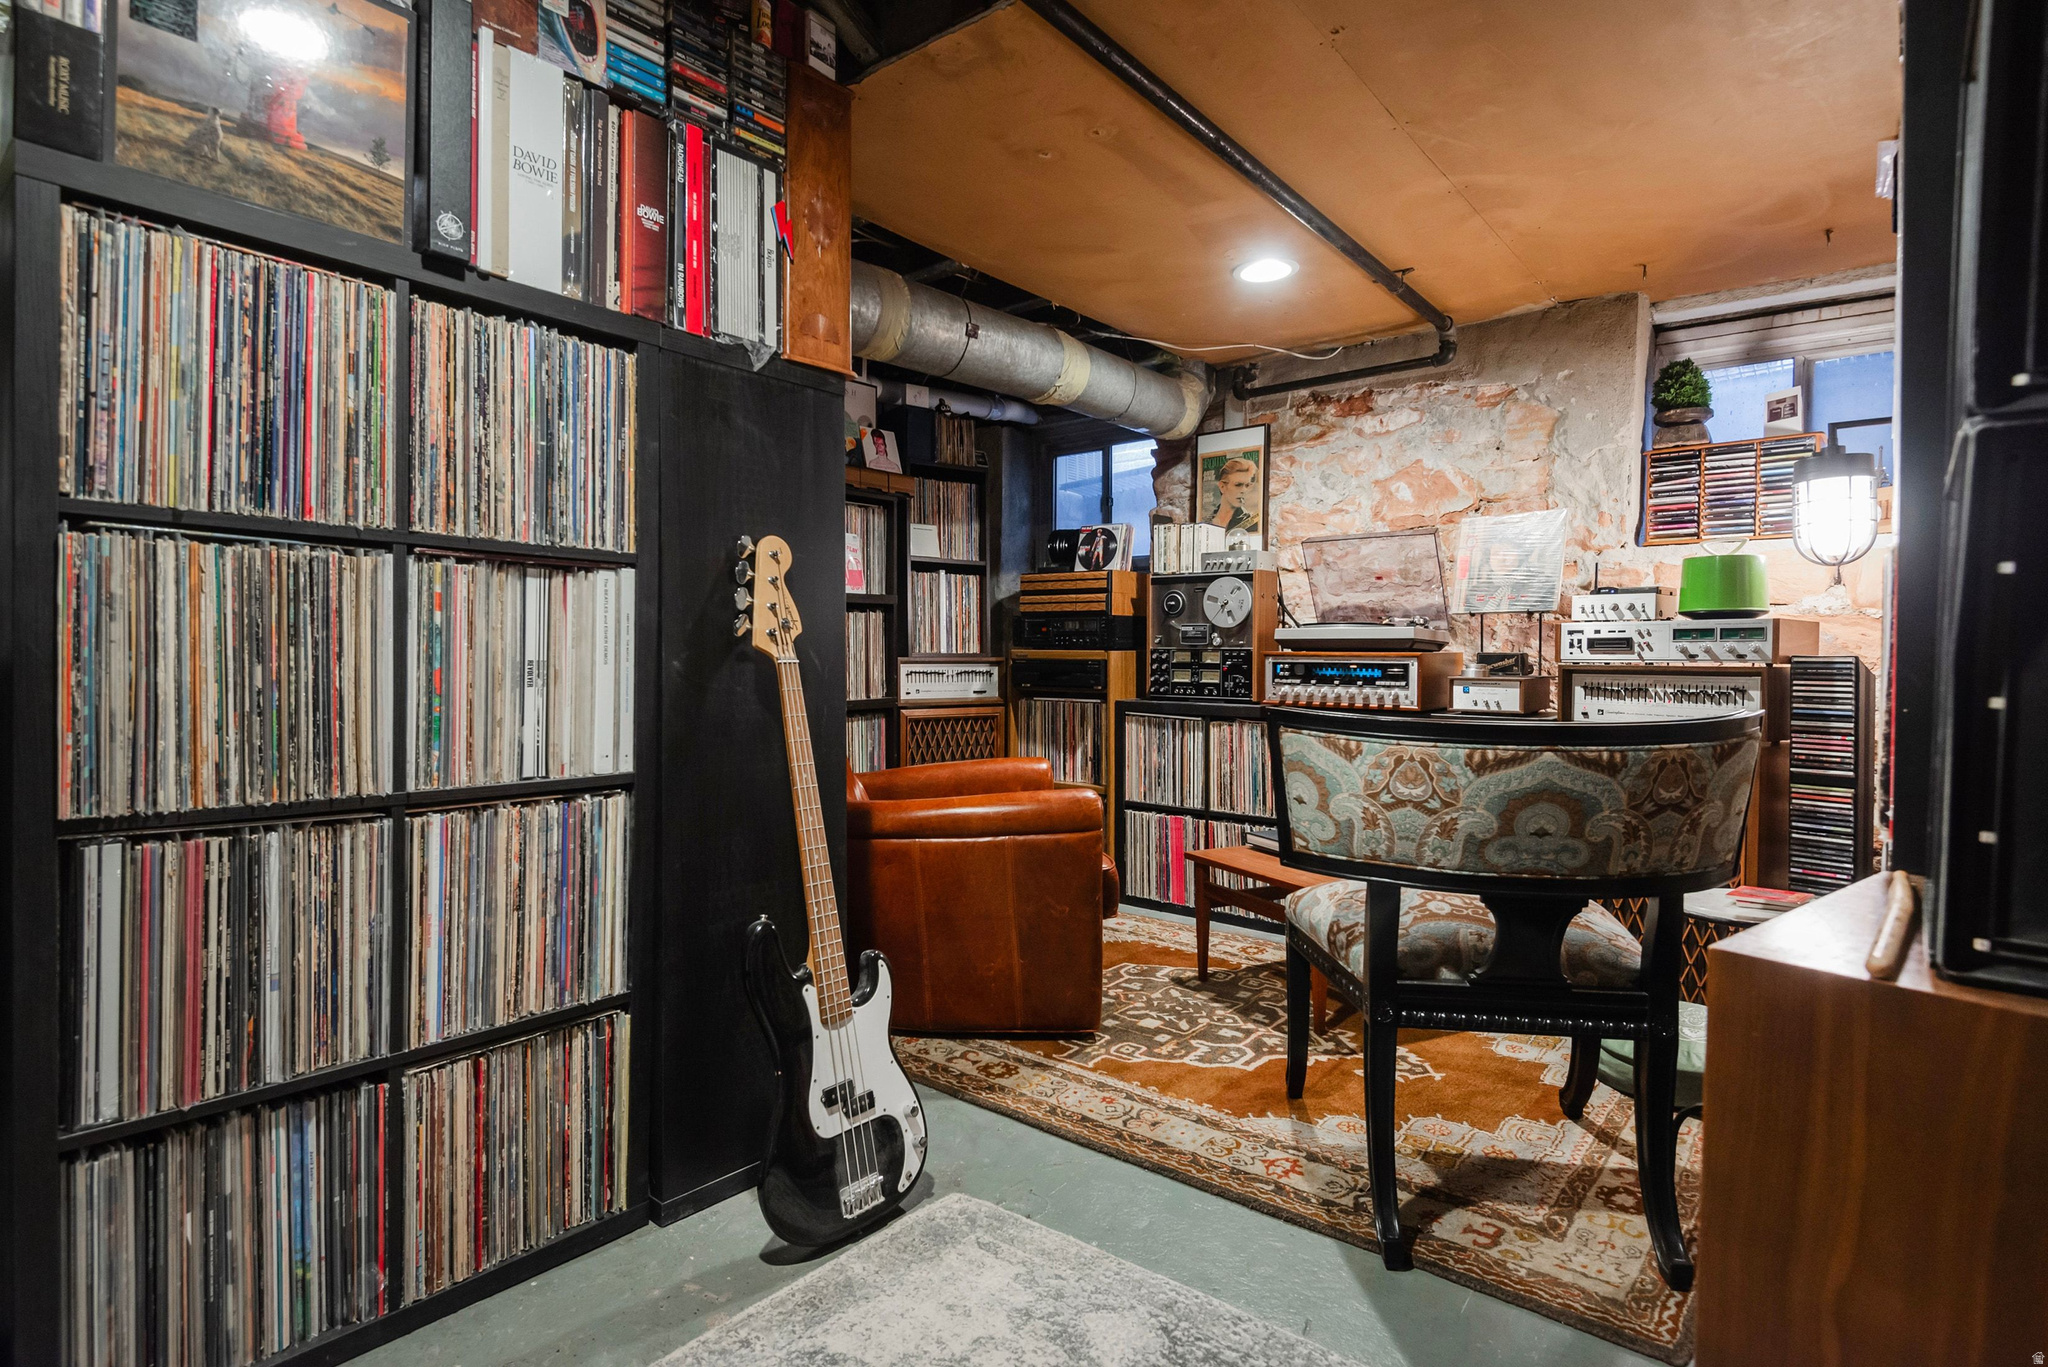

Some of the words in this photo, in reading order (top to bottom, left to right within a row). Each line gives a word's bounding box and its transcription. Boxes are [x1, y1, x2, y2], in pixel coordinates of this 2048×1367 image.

[490, 22, 502, 30] Video
[502, 26, 522, 38] Collection
[58, 56, 70, 84] ROXY
[58, 82, 70, 115] MUSIC
[611, 121, 616, 130] 60
[513, 145, 557, 170] DAVID
[513, 158, 558, 184] BOWIE
[637, 207, 665, 224] BOWIE
[677, 262, 684, 271] IN
